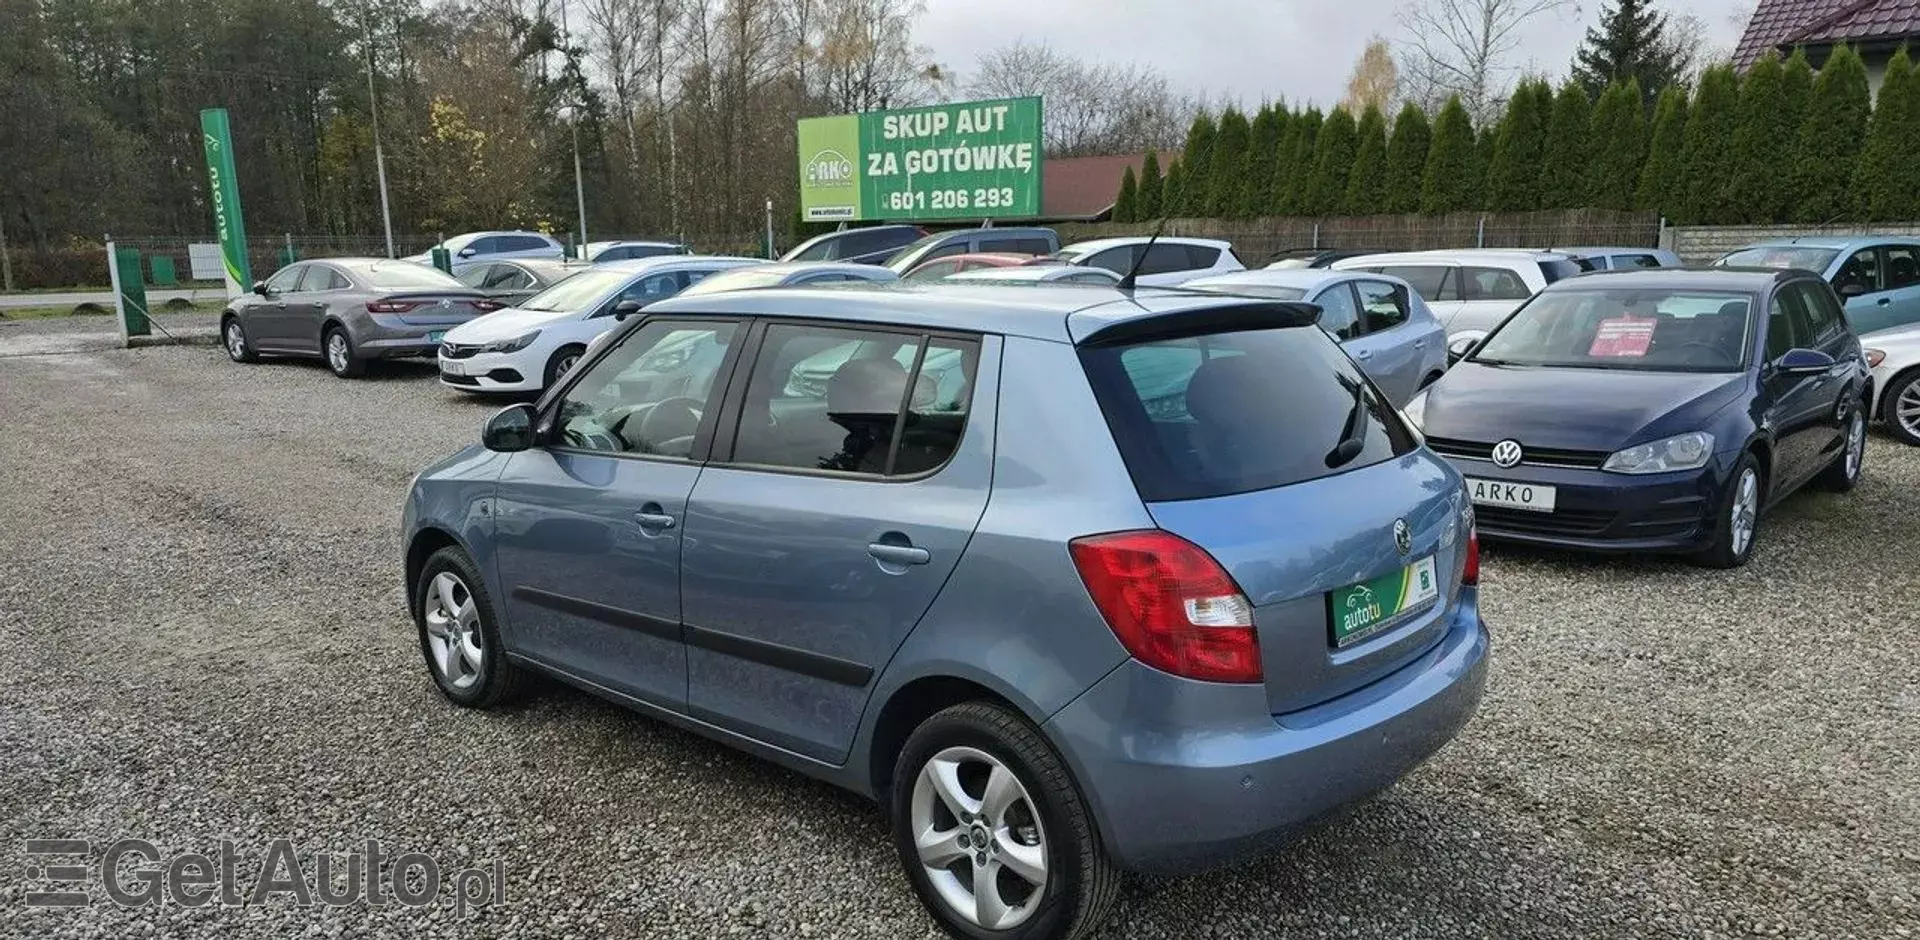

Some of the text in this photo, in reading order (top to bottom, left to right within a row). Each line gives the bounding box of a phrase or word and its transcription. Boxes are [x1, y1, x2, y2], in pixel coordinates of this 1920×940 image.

[883, 106, 1009, 140] SKUP AUT
[867, 140, 1032, 177] ZA GOTÓWKĘ
[210, 167, 228, 241] autotu
[890, 187, 1014, 211] 601 206 293
[1475, 482, 1533, 503] ARKO
[1343, 602, 1381, 631] autotu
